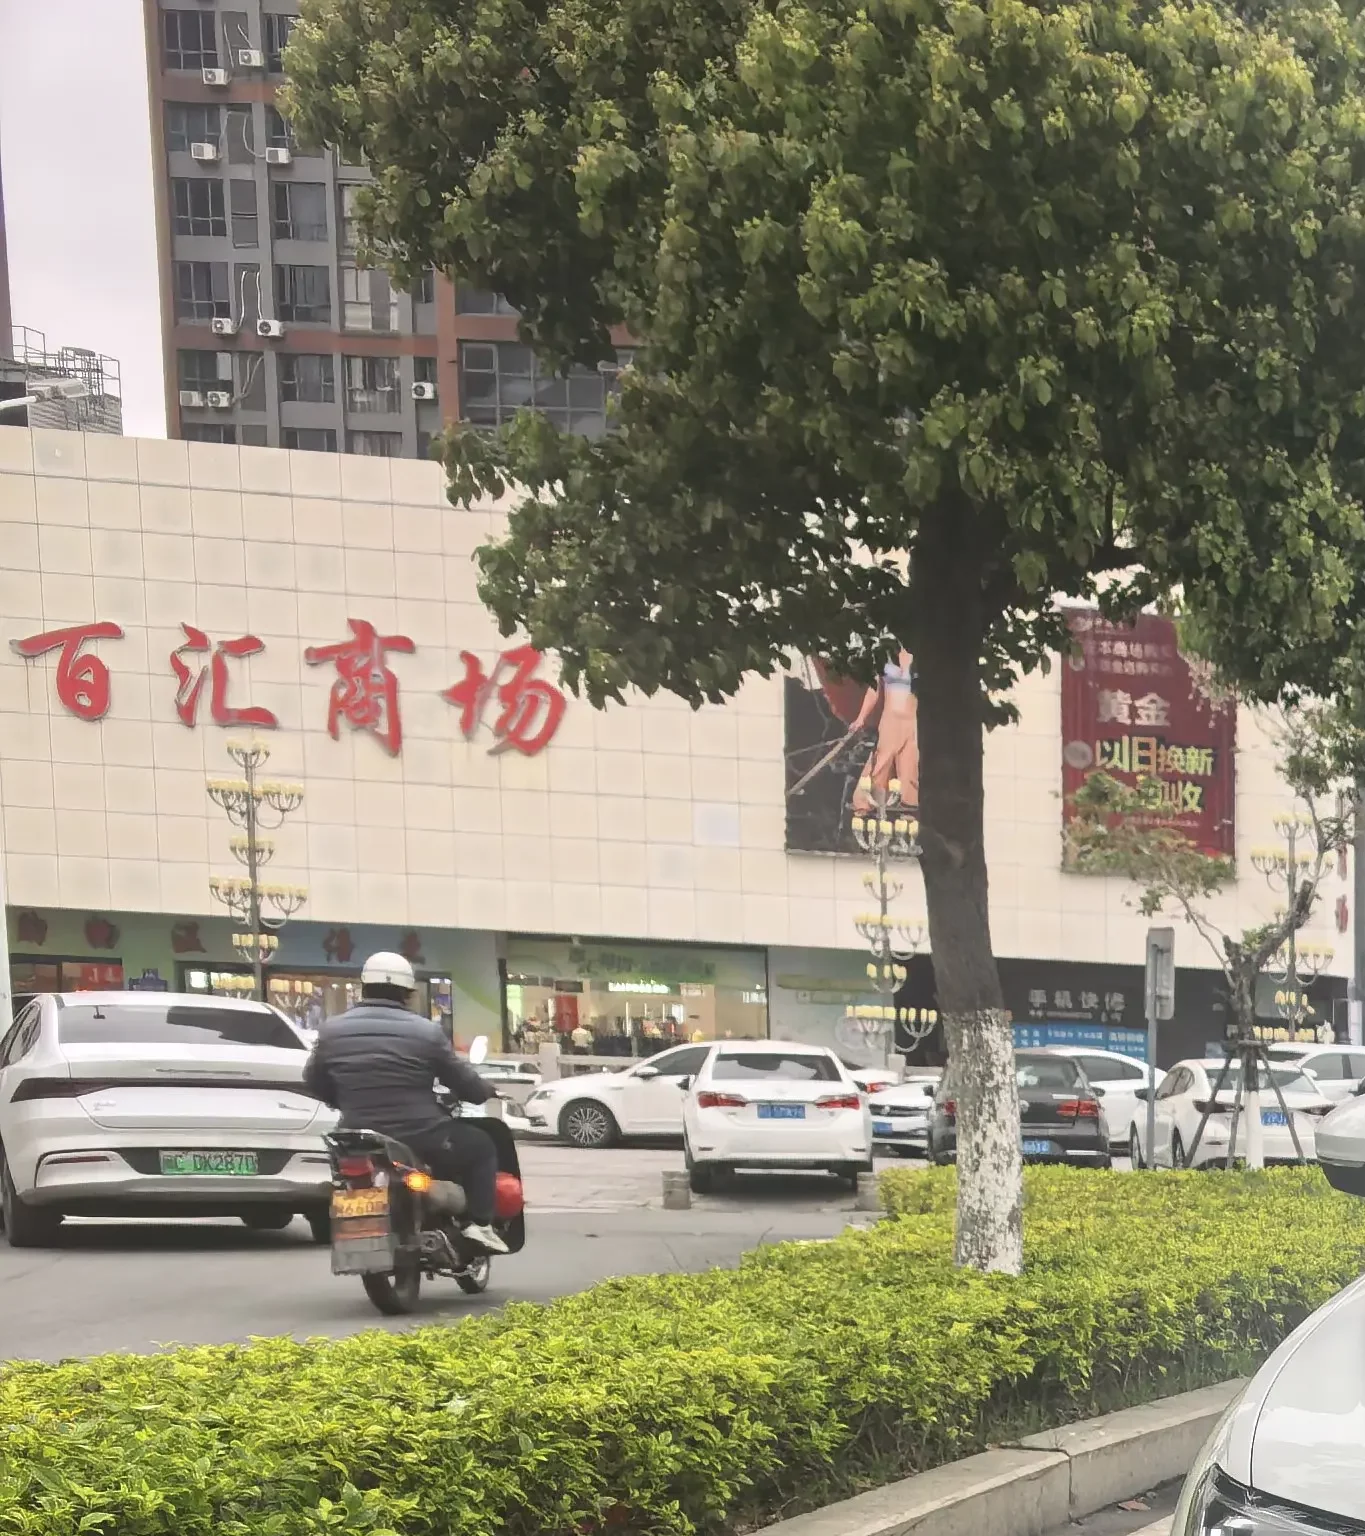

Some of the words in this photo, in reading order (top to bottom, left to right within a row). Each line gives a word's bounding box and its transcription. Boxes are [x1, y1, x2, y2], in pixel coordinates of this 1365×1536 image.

[10, 618, 567, 757] 百汇商场
[1097, 689, 1171, 727] 黄金
[1095, 735, 1214, 776] 以旧换新
